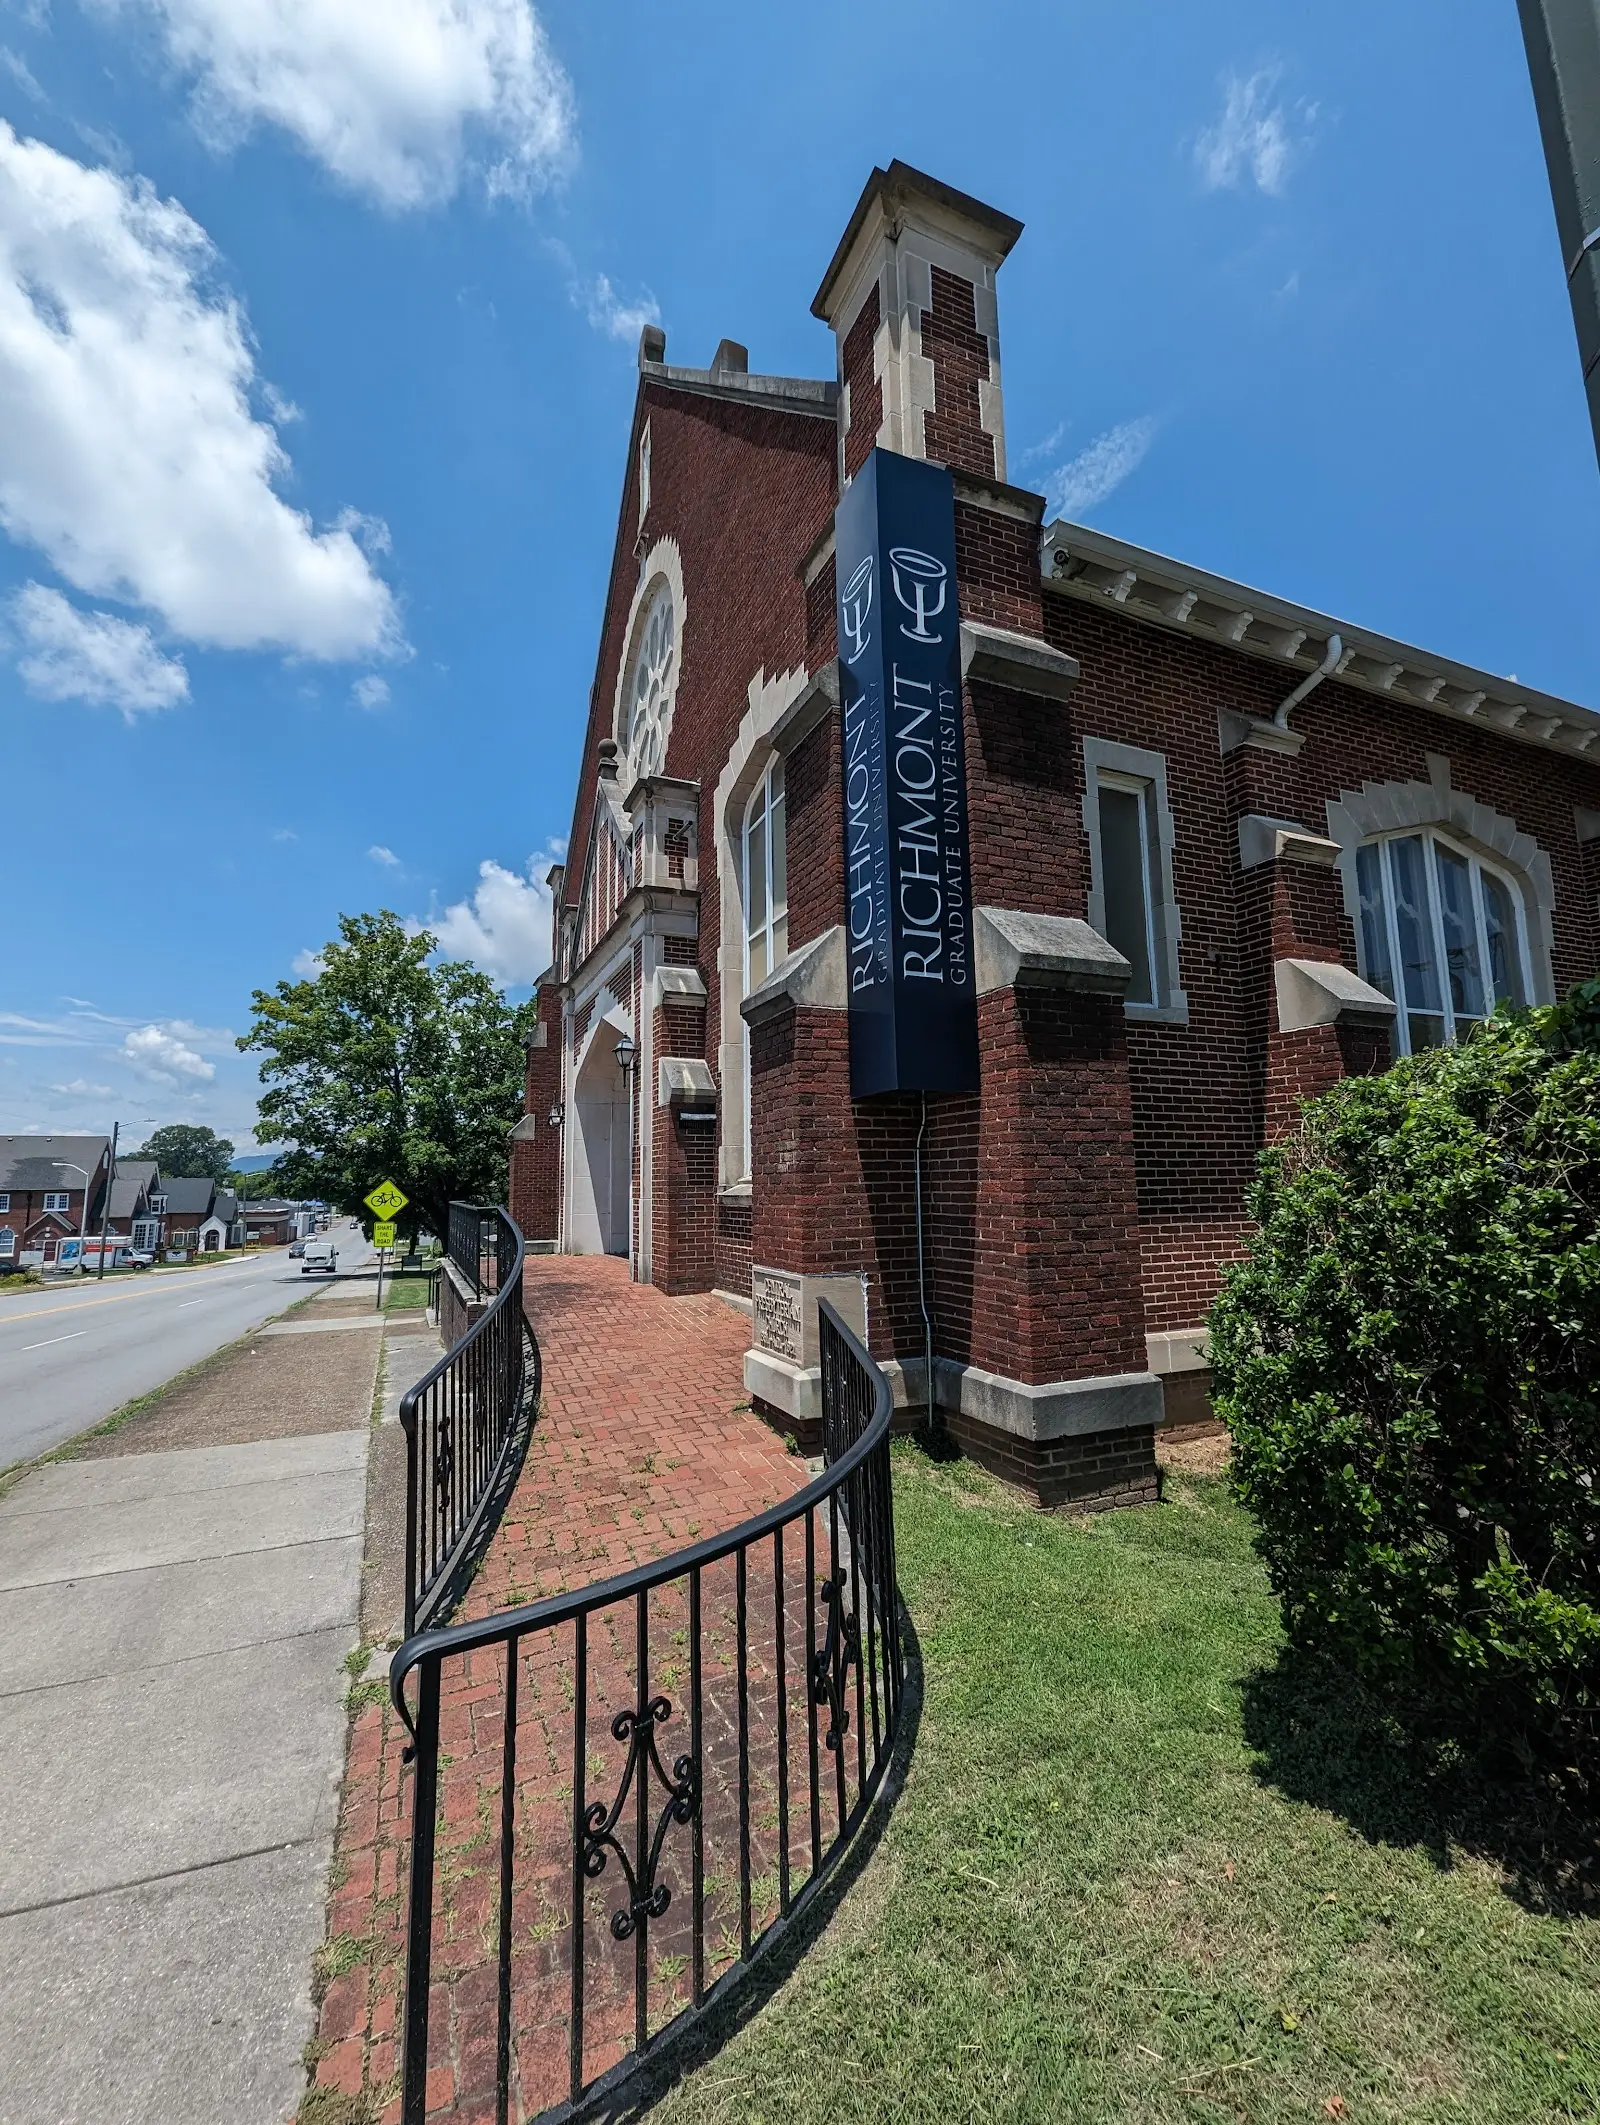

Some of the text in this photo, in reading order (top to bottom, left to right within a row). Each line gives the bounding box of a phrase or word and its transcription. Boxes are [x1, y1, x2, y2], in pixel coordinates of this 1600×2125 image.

[845, 694, 875, 994] RICHMONT
[869, 681, 888, 983] GRADUATE UNIVERSITY
[892, 662, 944, 983] RICHMONT
[938, 682, 967, 985] GRADUATE UNIVERSITY
[755, 1294, 801, 1323] PRESBYTERIAN
